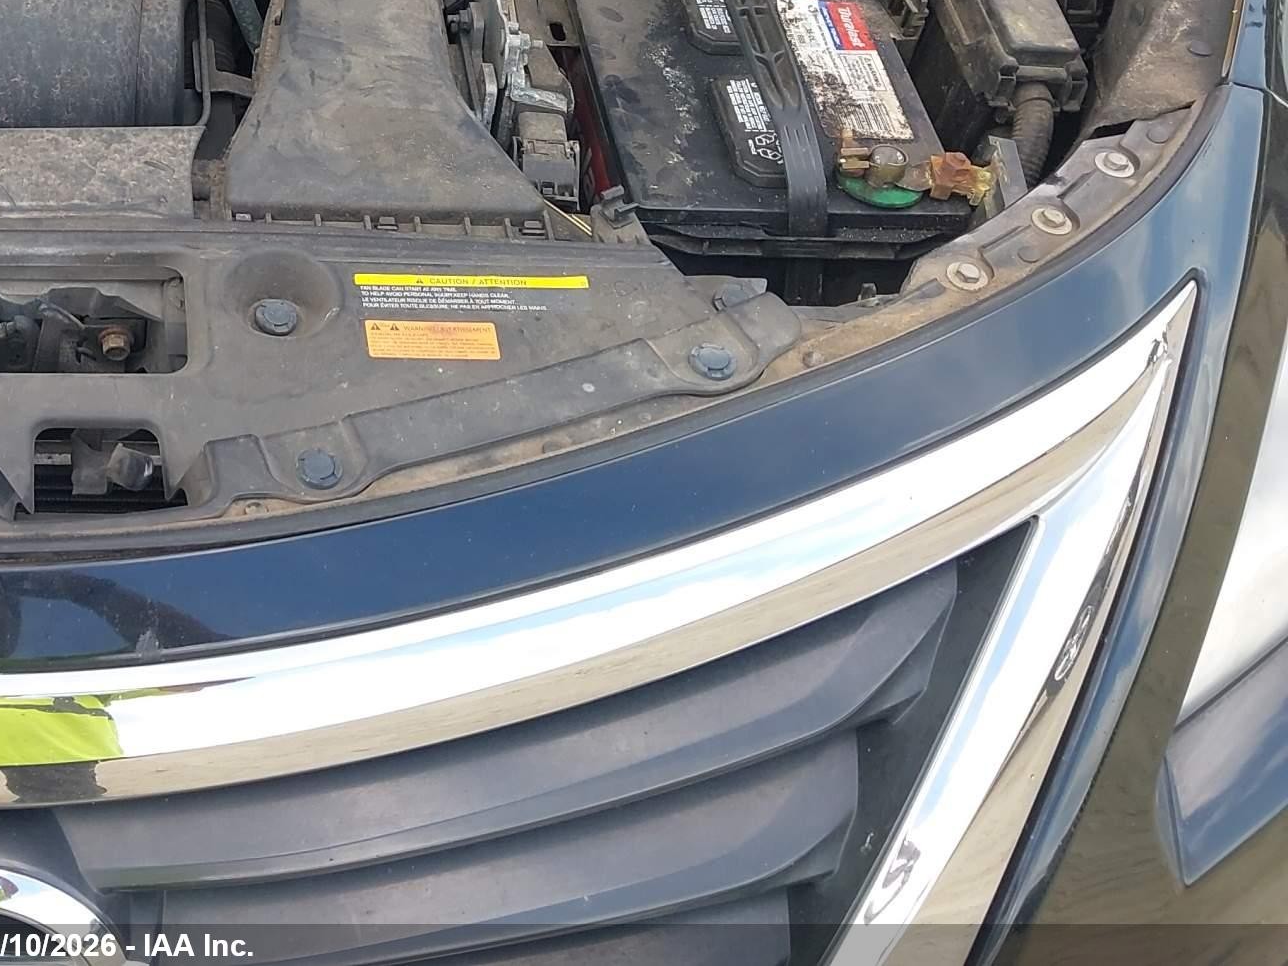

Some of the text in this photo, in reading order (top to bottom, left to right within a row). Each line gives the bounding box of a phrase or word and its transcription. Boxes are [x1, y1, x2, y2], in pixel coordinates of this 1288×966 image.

[837, 6, 866, 48] Duralast
[429, 277, 469, 285] CAUTION
[478, 278, 528, 286] ATTENTION
